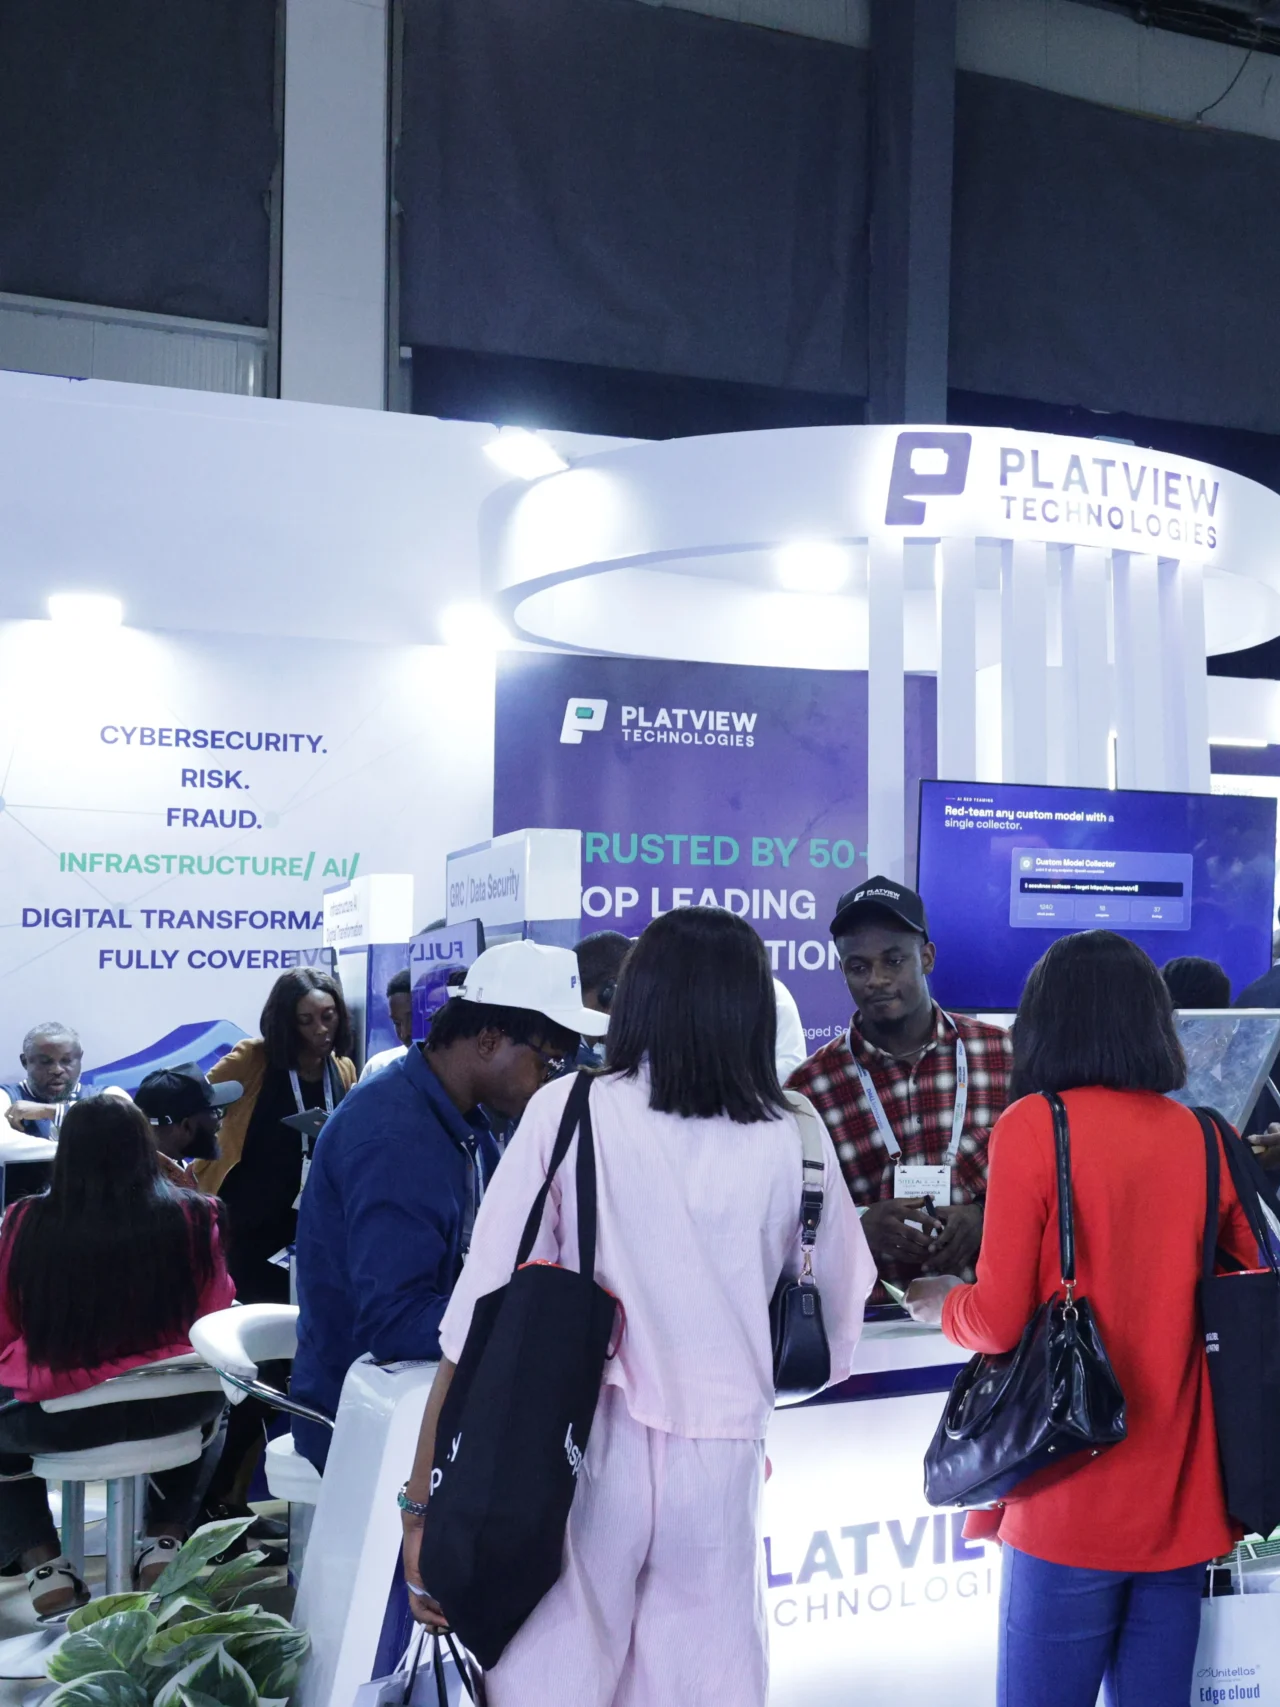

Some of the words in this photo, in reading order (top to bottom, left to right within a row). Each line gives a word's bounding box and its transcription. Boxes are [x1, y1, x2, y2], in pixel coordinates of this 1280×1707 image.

[999, 446, 1219, 518] PLATVIEW
[1001, 495, 1217, 549] TECHNOLOGIES
[621, 705, 757, 733] PLATVIEW
[99, 725, 328, 754] CYBERSECURITY.
[621, 728, 755, 748] TECHNOLOGIES
[181, 768, 250, 790] RISK.
[166, 807, 262, 829] FRAUD.
[945, 805, 994, 817] Red-team
[996, 809, 1014, 820] any
[1016, 809, 1053, 820] custom
[1055, 811, 1084, 821] model
[1086, 812, 1107, 822] with
[1108, 815, 1114, 823] a
[945, 817, 974, 830] single
[976, 819, 1022, 830] collector.
[581, 832, 740, 866] RUSTED
[752, 836, 798, 867] BY
[59, 851, 316, 881] INFRASTRUCTURE/
[322, 852, 360, 880] AI/
[1035, 857, 1062, 866] Custom
[1063, 858, 1084, 867] Model
[1085, 859, 1116, 868] Collector
[450, 881, 464, 908] GRC
[470, 878, 486, 904] Data
[487, 868, 519, 901] Security
[866, 888, 900, 898] PLATVIEW
[581, 885, 639, 917] OP
[651, 887, 816, 920] LEADING
[22, 908, 132, 929] DIGITAL
[140, 909, 324, 930] TRANSFORMA
[98, 950, 180, 970] FULLY
[187, 950, 292, 970] COVERE
[763, 1511, 986, 1589] LATVIE
[773, 1568, 992, 1627] CHNOLOGI
[1211, 1666, 1256, 1678] Unitellas
[1200, 1687, 1226, 1705] Edge
[1228, 1684, 1261, 1700] cloud
